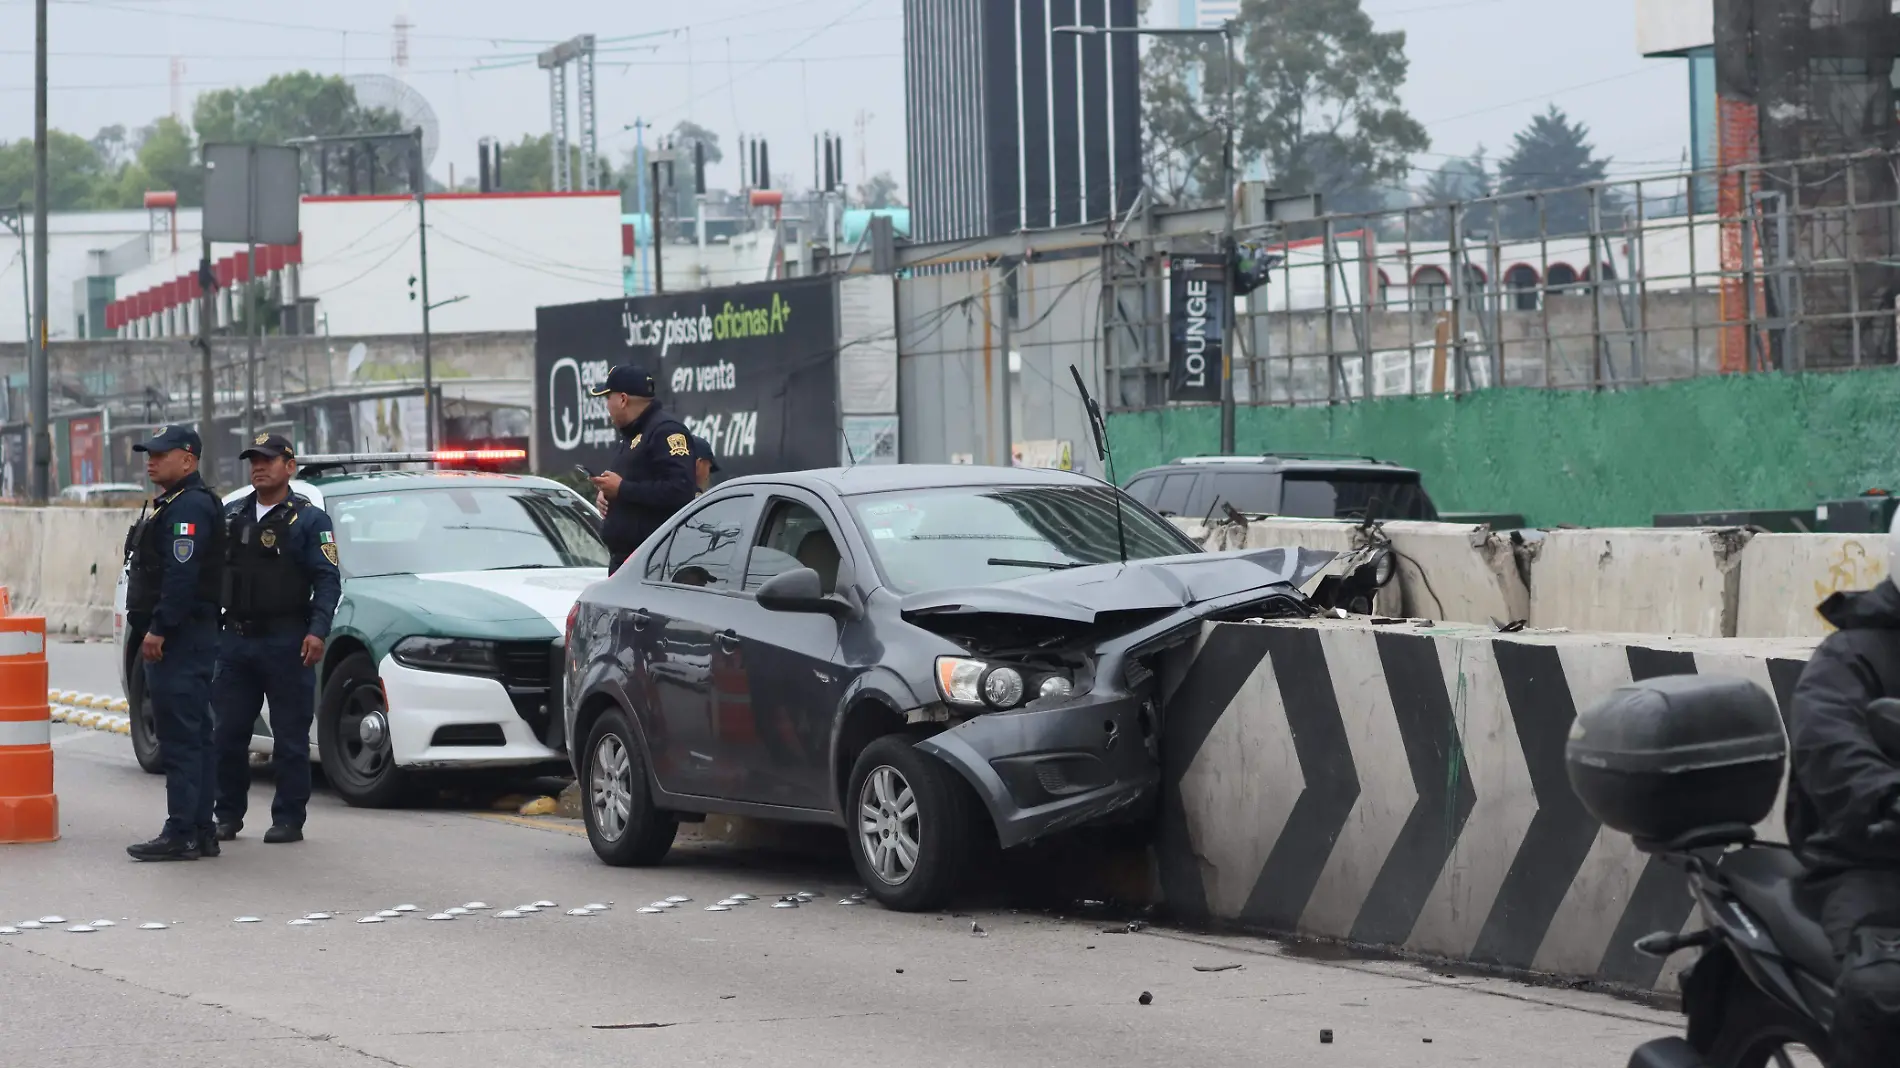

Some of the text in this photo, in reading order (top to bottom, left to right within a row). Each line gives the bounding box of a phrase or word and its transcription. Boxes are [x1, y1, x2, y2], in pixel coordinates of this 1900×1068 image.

[661, 311, 698, 357] pisos
[698, 304, 713, 343] de
[714, 301, 768, 341] oficinas
[770, 292, 791, 334] A+
[1186, 280, 1208, 387] LOUNGE
[671, 359, 736, 393] en venta
